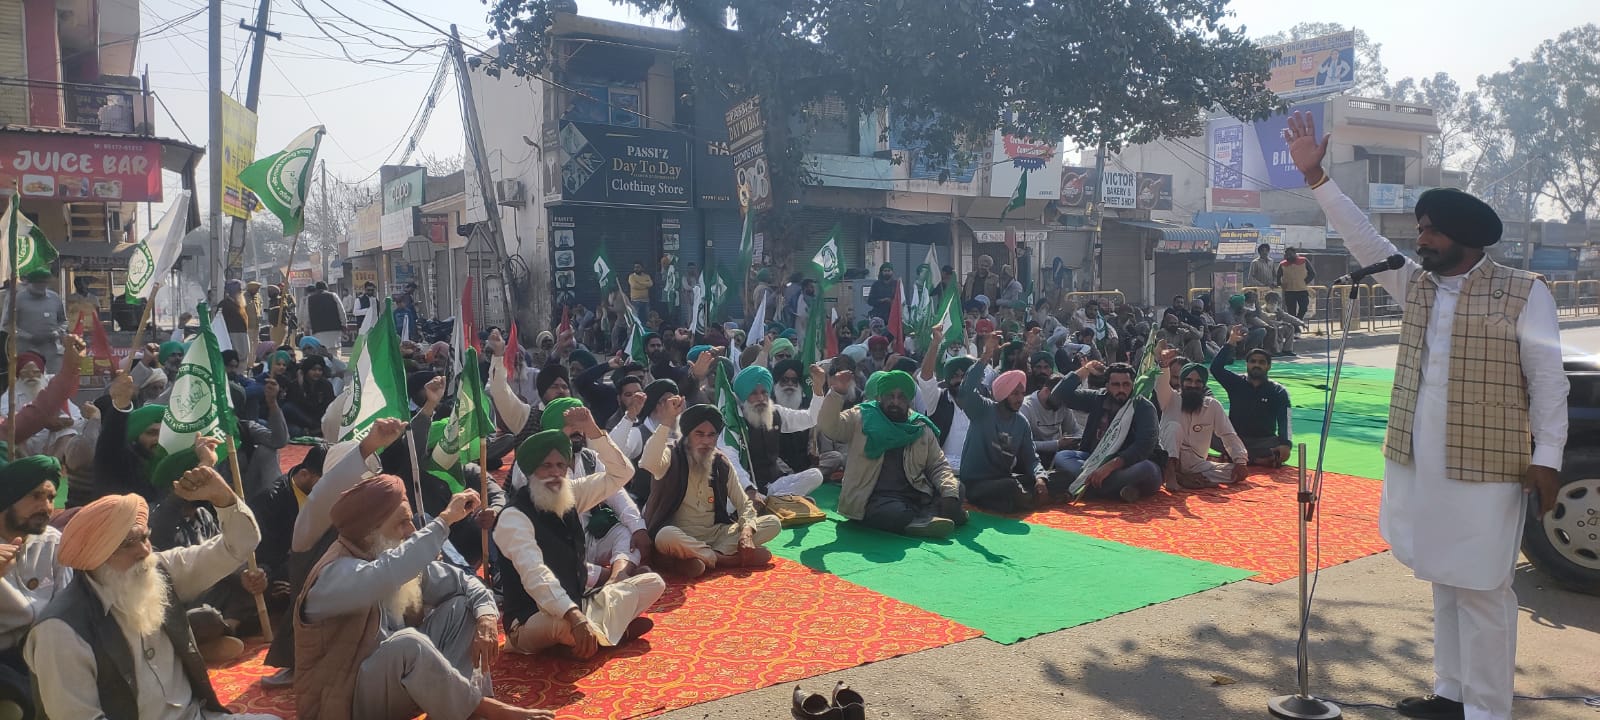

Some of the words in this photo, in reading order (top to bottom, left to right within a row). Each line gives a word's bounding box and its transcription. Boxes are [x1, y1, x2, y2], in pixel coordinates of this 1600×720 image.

[12, 150, 94, 174] JUICE
[102, 154, 148, 175] BAR
[613, 157, 637, 176] Day
[640, 160, 656, 174] To
[659, 161, 682, 179] Day
[611, 178, 656, 196] Clothing
[658, 182, 684, 195] Store
[1104, 172, 1134, 187] VICTOR
[1106, 186, 1126, 195] BAKERY
[1104, 196, 1120, 206] SWEET
[1121, 197, 1135, 206] SHOP
